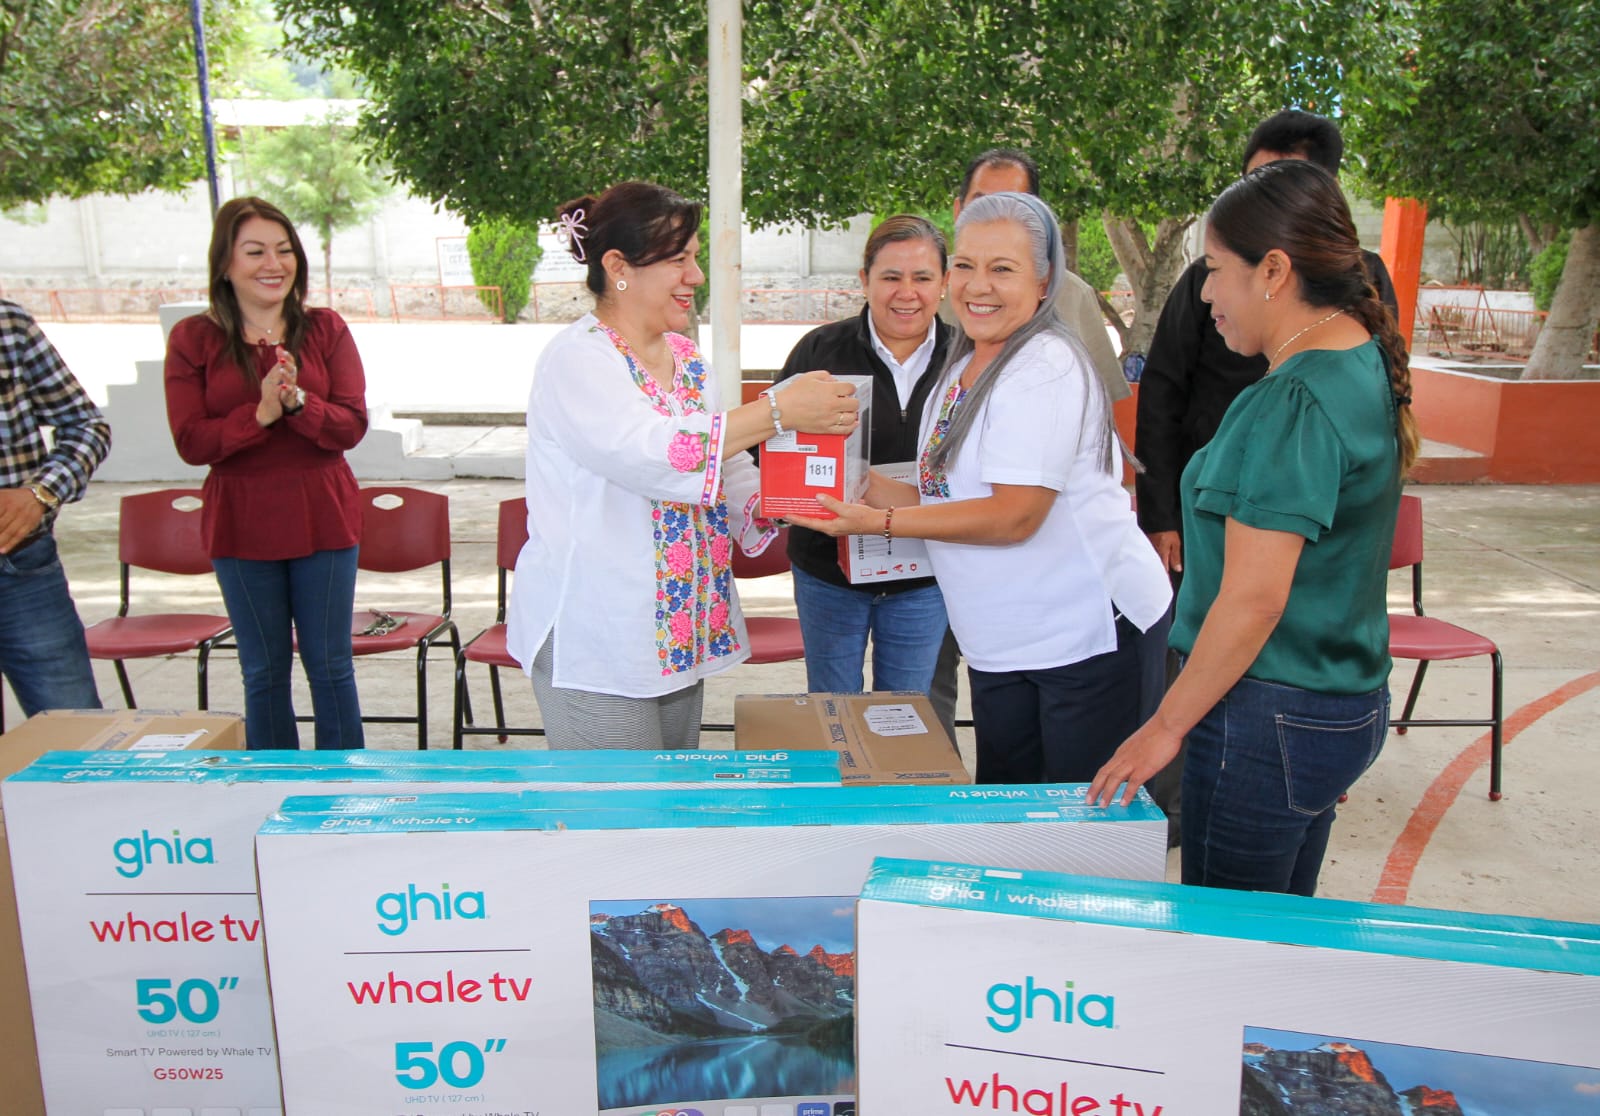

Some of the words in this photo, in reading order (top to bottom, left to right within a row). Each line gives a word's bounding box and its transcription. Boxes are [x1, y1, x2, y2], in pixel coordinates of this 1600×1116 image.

[808, 464, 834, 477] 1811
[674, 753, 728, 762] whale
[745, 752, 789, 762] ghia
[129, 768, 185, 777] whale
[949, 790, 969, 799] tv
[970, 789, 1029, 799] whale
[319, 816, 373, 830] ghia
[391, 815, 451, 826] whale
[455, 815, 477, 825] tv
[113, 829, 214, 879] ghia
[929, 884, 985, 900] ghia
[376, 883, 485, 936] ghia
[90, 912, 214, 942] whale
[220, 915, 260, 942] tv
[348, 970, 482, 1005] whale
[489, 973, 533, 1003] tv
[986, 976, 1115, 1033] ghia
[146, 1029, 167, 1038] UHD
[169, 1029, 180, 1038] TV
[106, 1047, 138, 1058] Smart
[140, 1047, 155, 1057] TV
[158, 1047, 204, 1057] Powered
[207, 1046, 219, 1059] by
[221, 1047, 254, 1057] Whale
[256, 1047, 272, 1057] TV
[154, 1068, 224, 1081] G50W25
[405, 1096, 427, 1104] UHD
[427, 1095, 440, 1104] TV
[448, 1094, 463, 1103] 127
[945, 1073, 1101, 1116] whale
